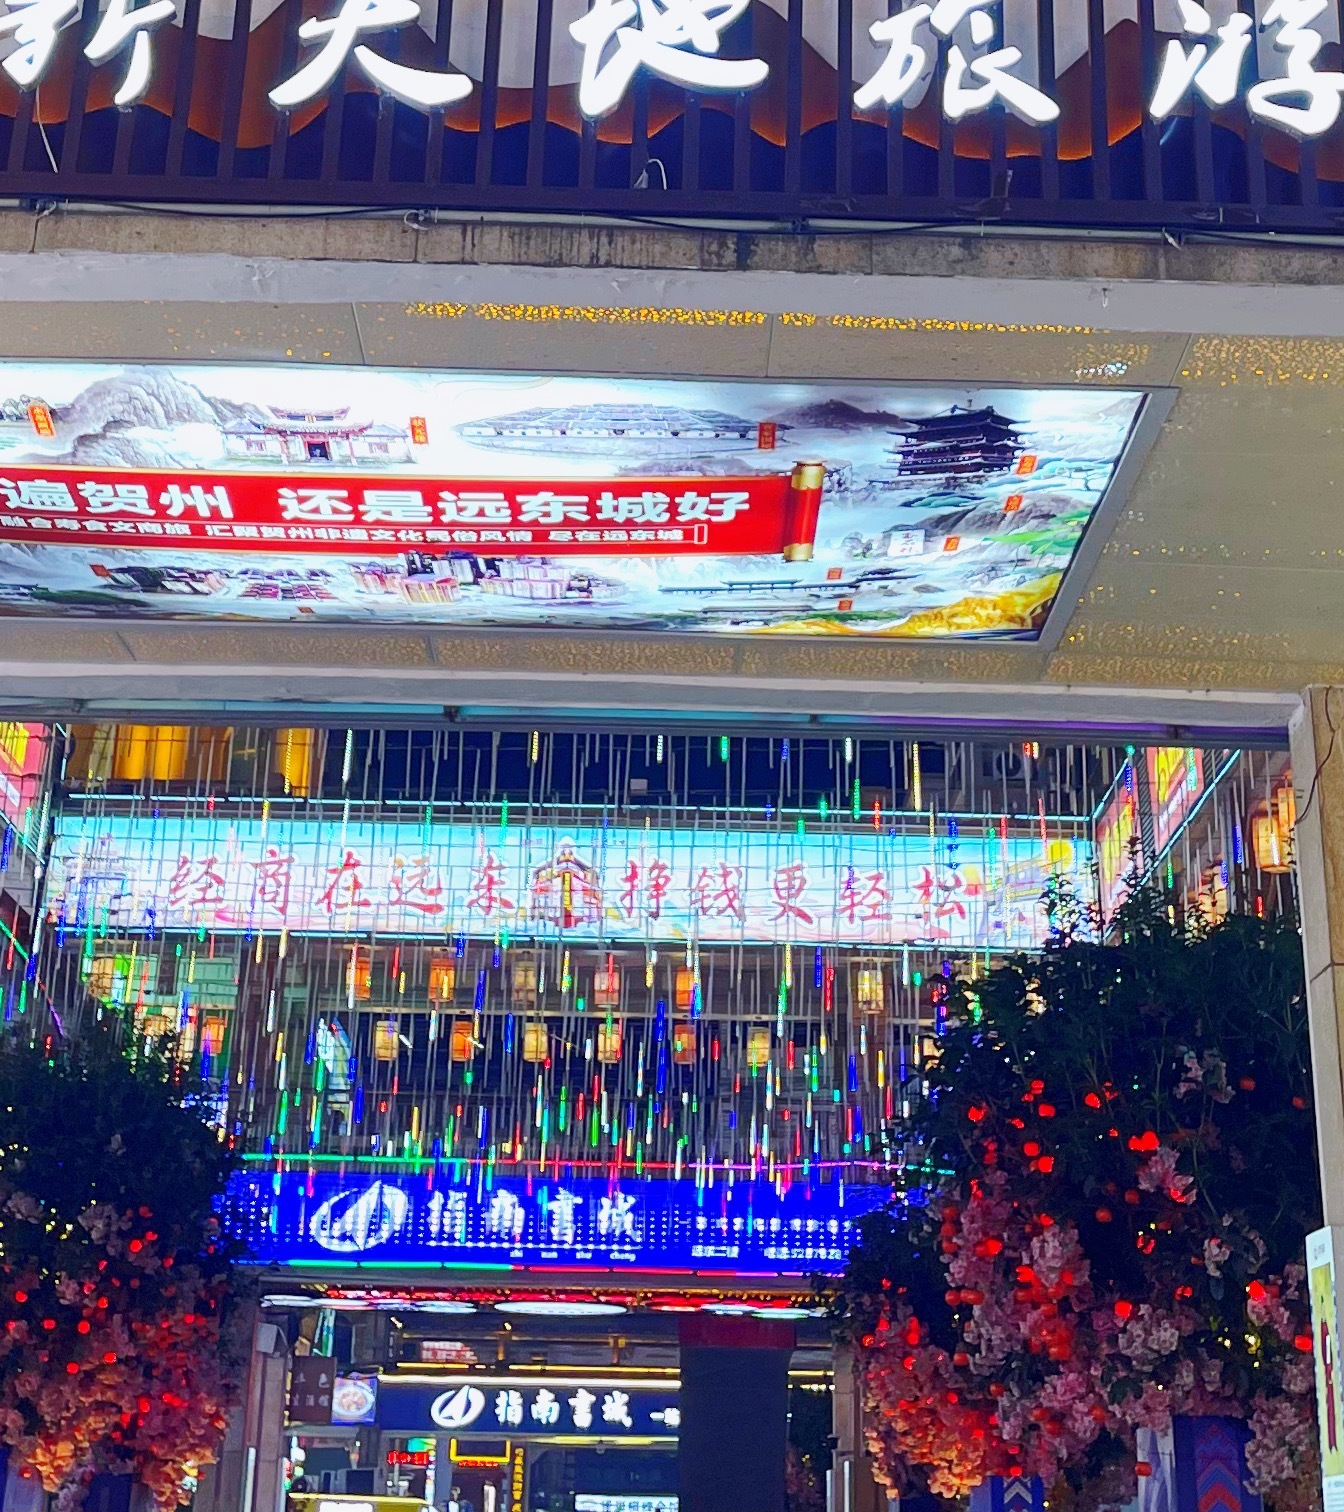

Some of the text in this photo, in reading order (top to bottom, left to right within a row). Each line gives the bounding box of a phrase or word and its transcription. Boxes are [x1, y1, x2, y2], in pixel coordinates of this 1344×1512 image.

[277, 486, 751, 524] 还是远东城好
[547, 528, 684, 543] 尽在远东城
[169, 846, 968, 925] 经商在远东 挣钱更轻松
